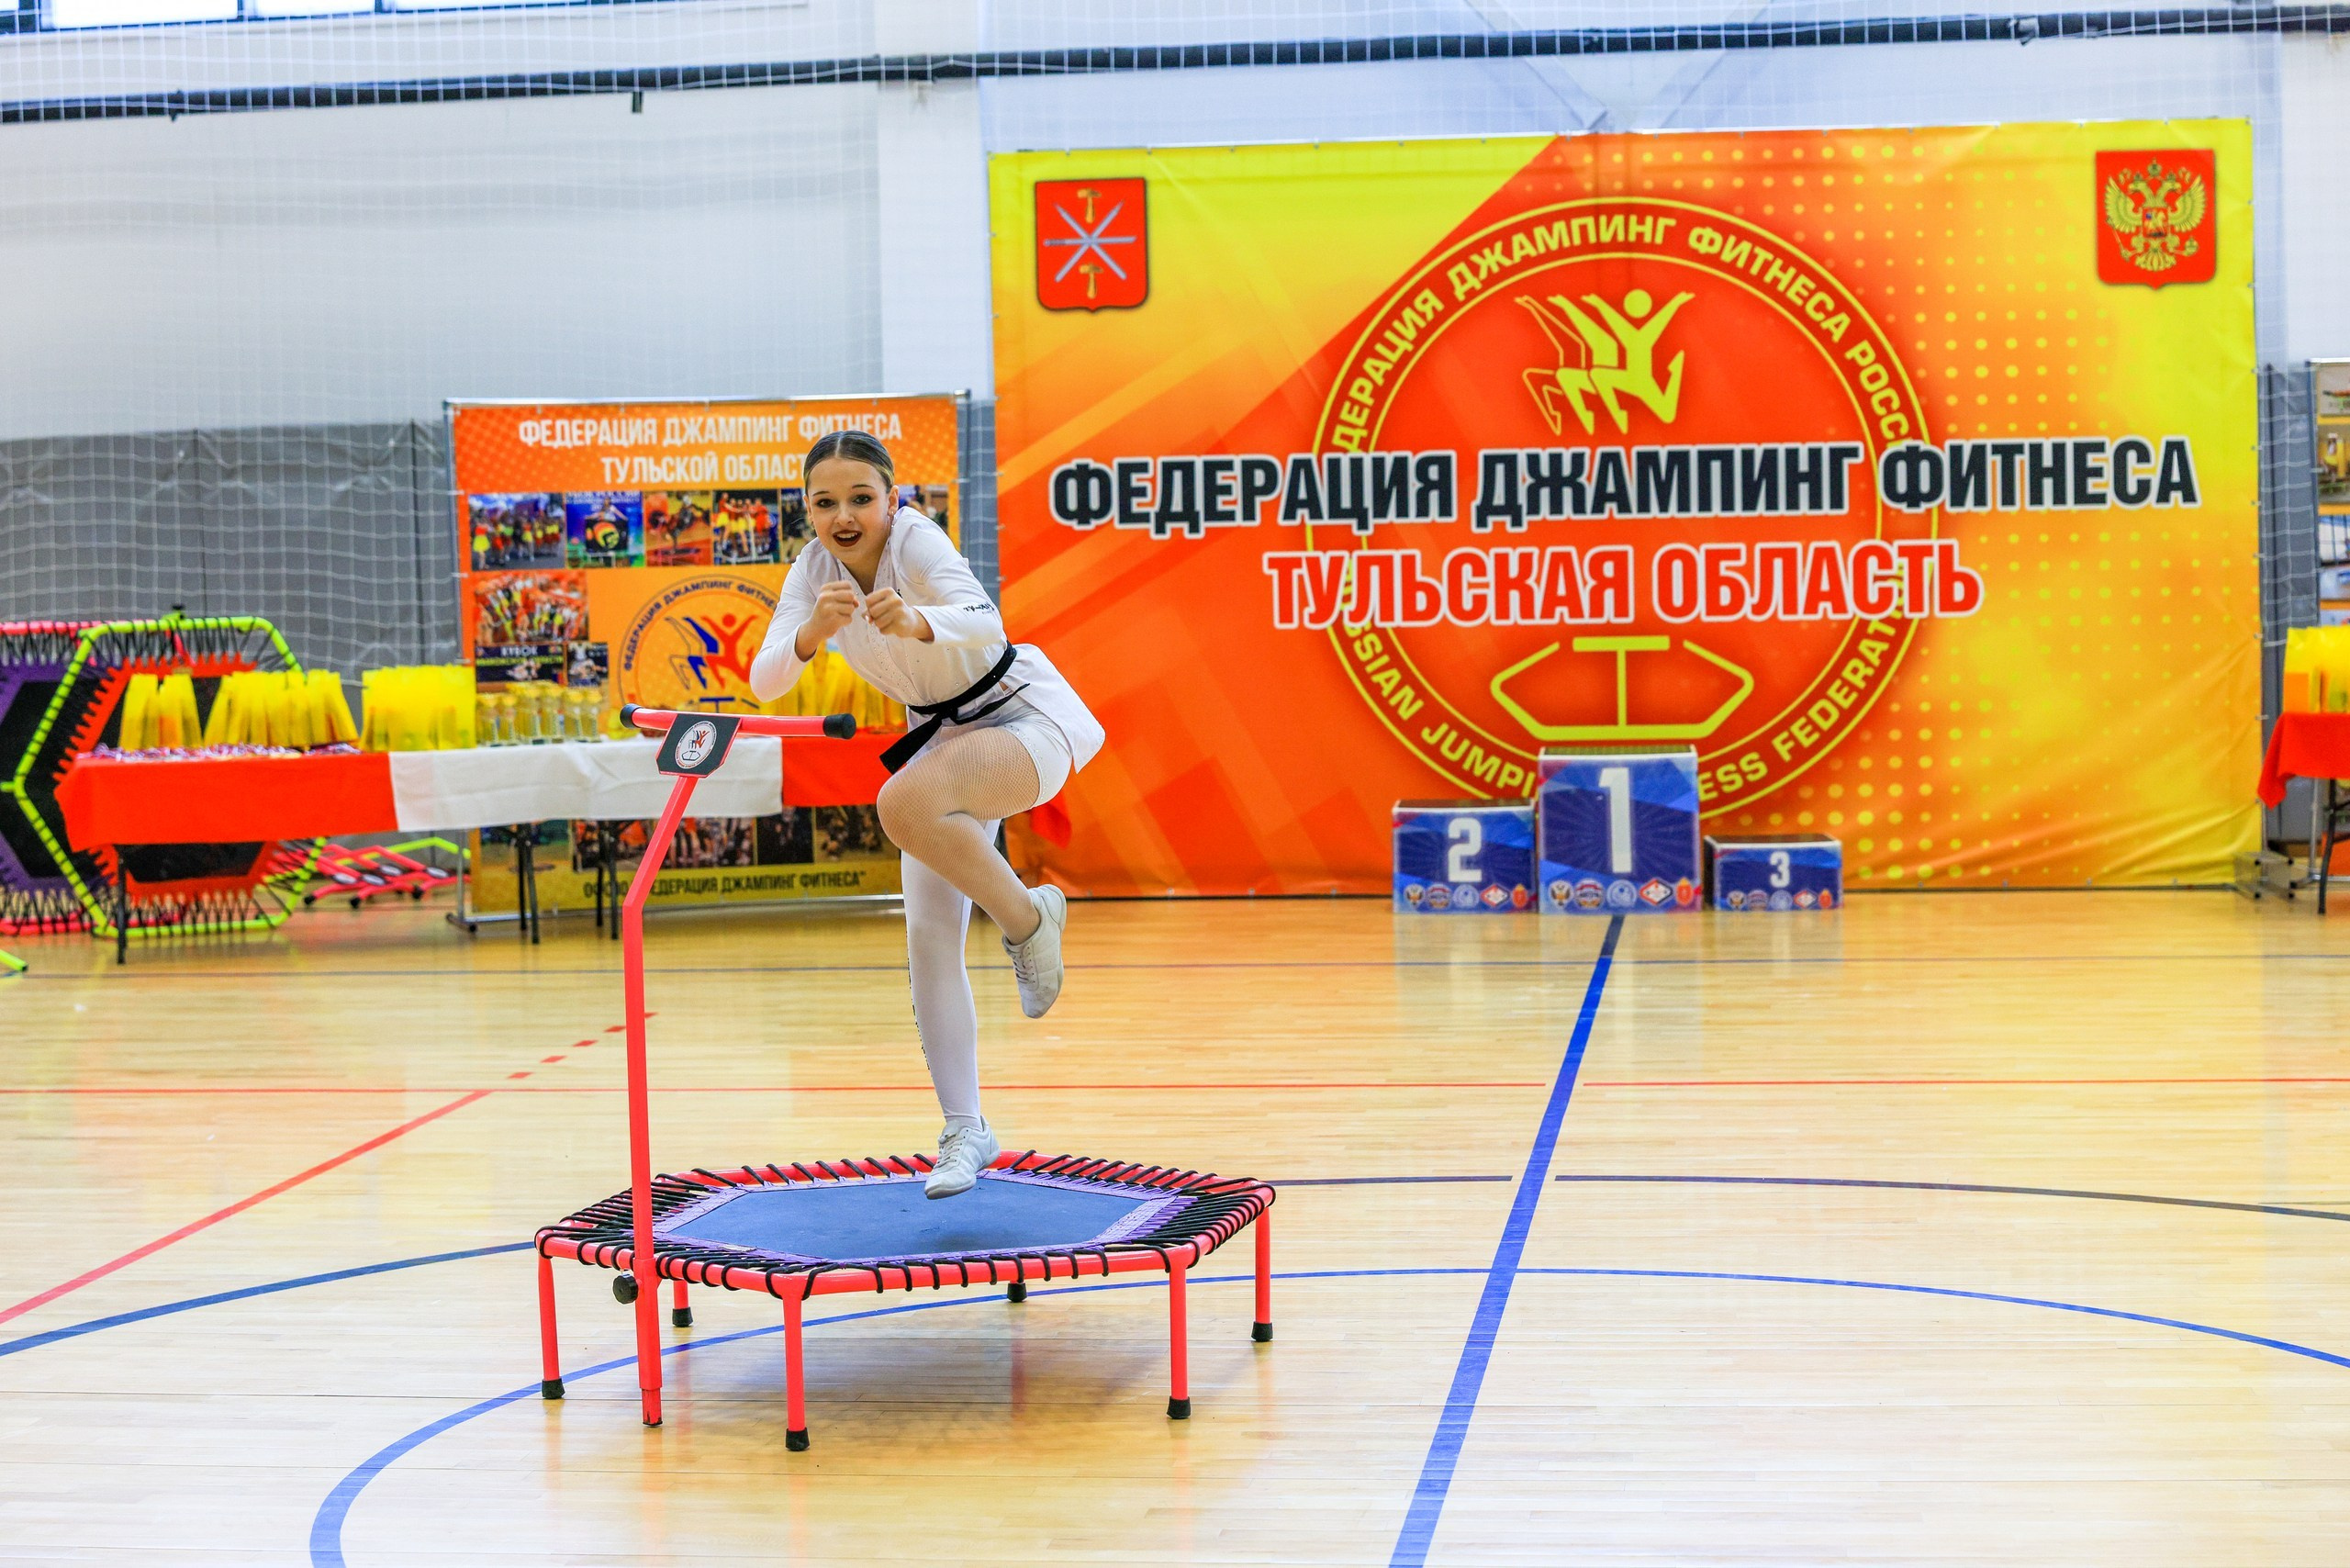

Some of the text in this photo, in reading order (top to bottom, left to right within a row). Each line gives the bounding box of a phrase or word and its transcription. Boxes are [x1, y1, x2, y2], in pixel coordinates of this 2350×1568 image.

[1447, 215, 1676, 301] ДЖАМПИНГ
[1688, 227, 1852, 343] ФИТНЕСА
[1844, 340, 1914, 450] РОСС
[519, 420, 657, 448] ФЕДЕРАЦИЯ
[664, 416, 793, 447] ДЖАМПИНГ
[601, 453, 806, 485] ТУЛЬСКОЙ ОБЛАСТ
[1049, 437, 2200, 538] ФЕДЕРАЦИЯ ДЖАМПИНГ ФИТНЕСА
[664, 579, 733, 606] ДЖАМПИНГ
[1263, 538, 1984, 629] ТУЛЬСКАЯ ОБЛАСТЬ
[1597, 766, 1632, 874] 1
[1447, 817, 1483, 883] 2
[1770, 851, 1791, 889] 3
[721, 873, 796, 893] ДЖАМПИНГ
